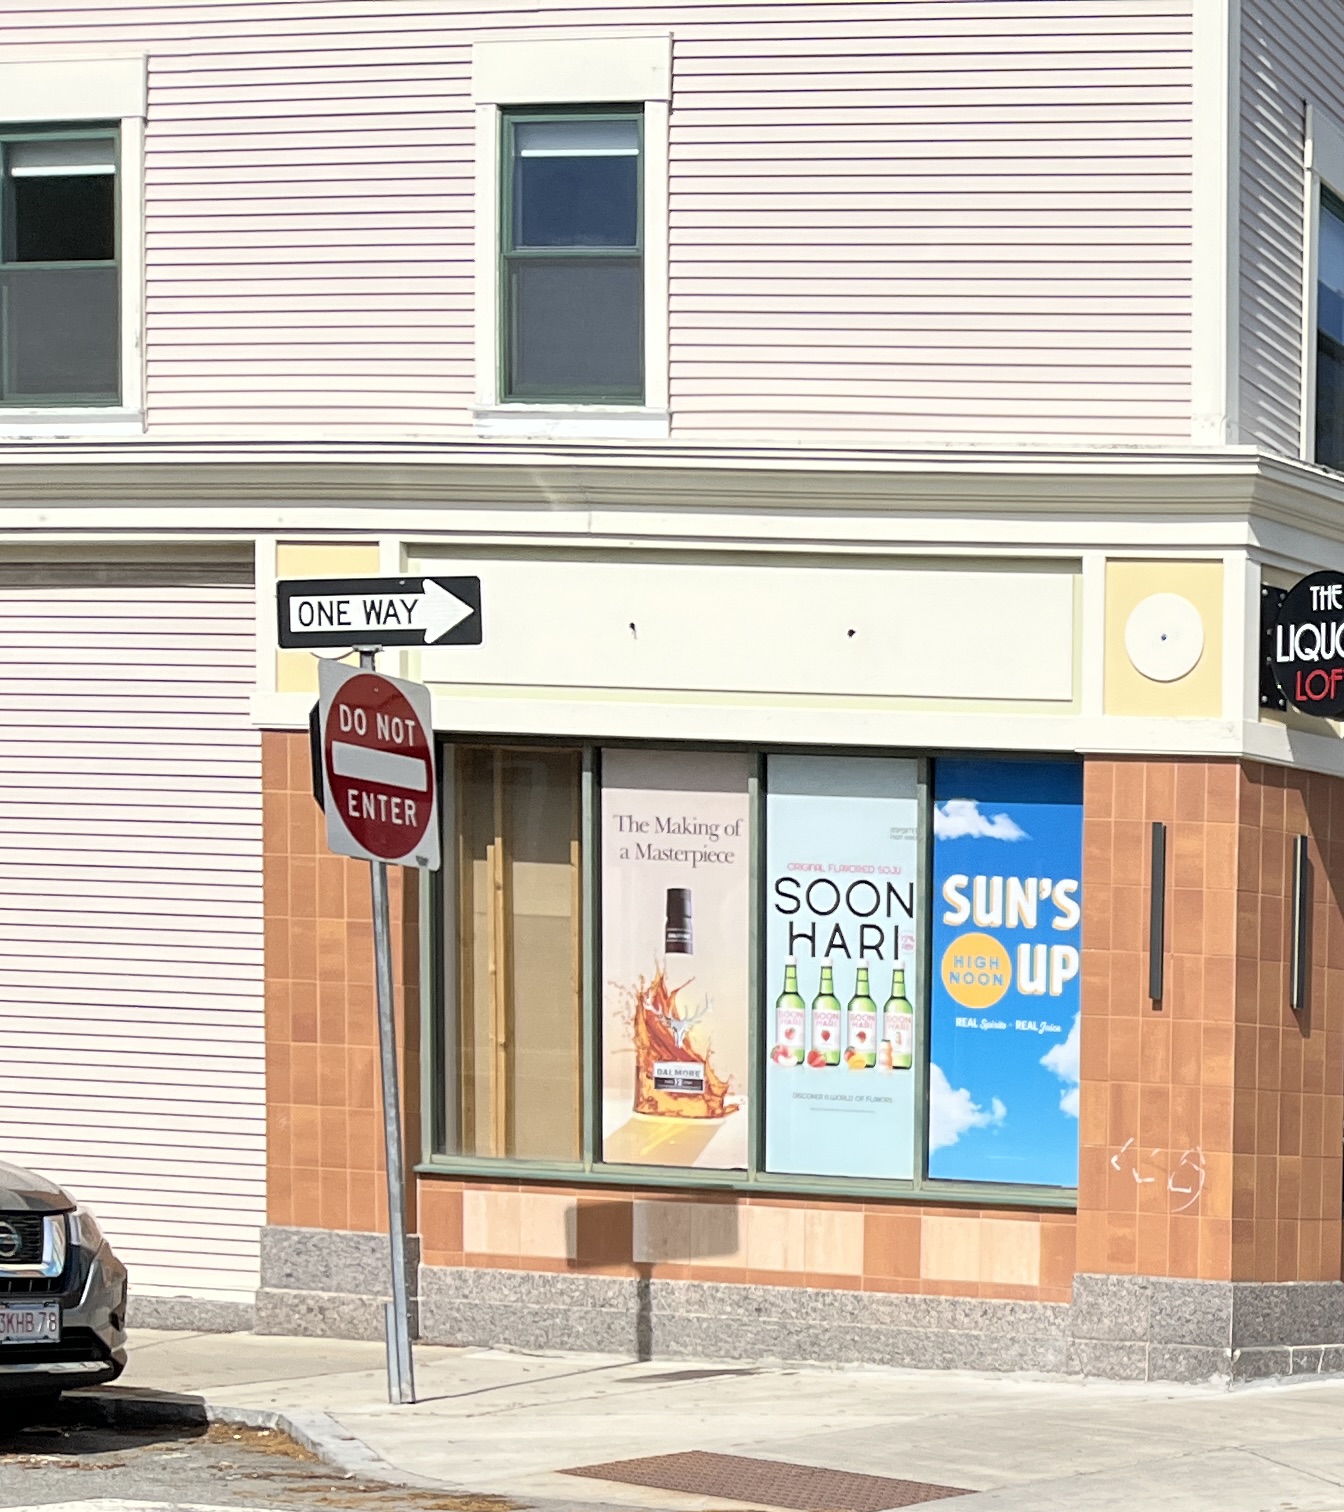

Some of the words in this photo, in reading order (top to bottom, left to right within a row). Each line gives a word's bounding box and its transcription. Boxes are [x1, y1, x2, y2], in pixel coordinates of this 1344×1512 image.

[1310, 584, 1342, 611] THE
[298, 600, 352, 627] ONE
[362, 598, 418, 625] WAY
[339, 703, 366, 736] DO
[377, 712, 416, 747] NOT
[348, 789, 417, 827] ENTER
[614, 815, 650, 835] The
[655, 817, 720, 841] Making
[723, 818, 744, 838] of
[620, 849, 628, 860] a
[634, 844, 734, 868] Masterpiece
[878, 866, 902, 875] SOJU
[774, 876, 914, 918] SOON
[942, 874, 1080, 930] SUN'S
[788, 921, 899, 960] HARI
[954, 954, 999, 970] HIGH
[1017, 942, 1079, 996] UP
[950, 972, 1004, 986] NOON
[956, 1017, 978, 1028] REAL
[1016, 1020, 1038, 1030] REAL
[656, 1068, 701, 1078] DALMORE
[38, 1312, 56, 1332] 78
